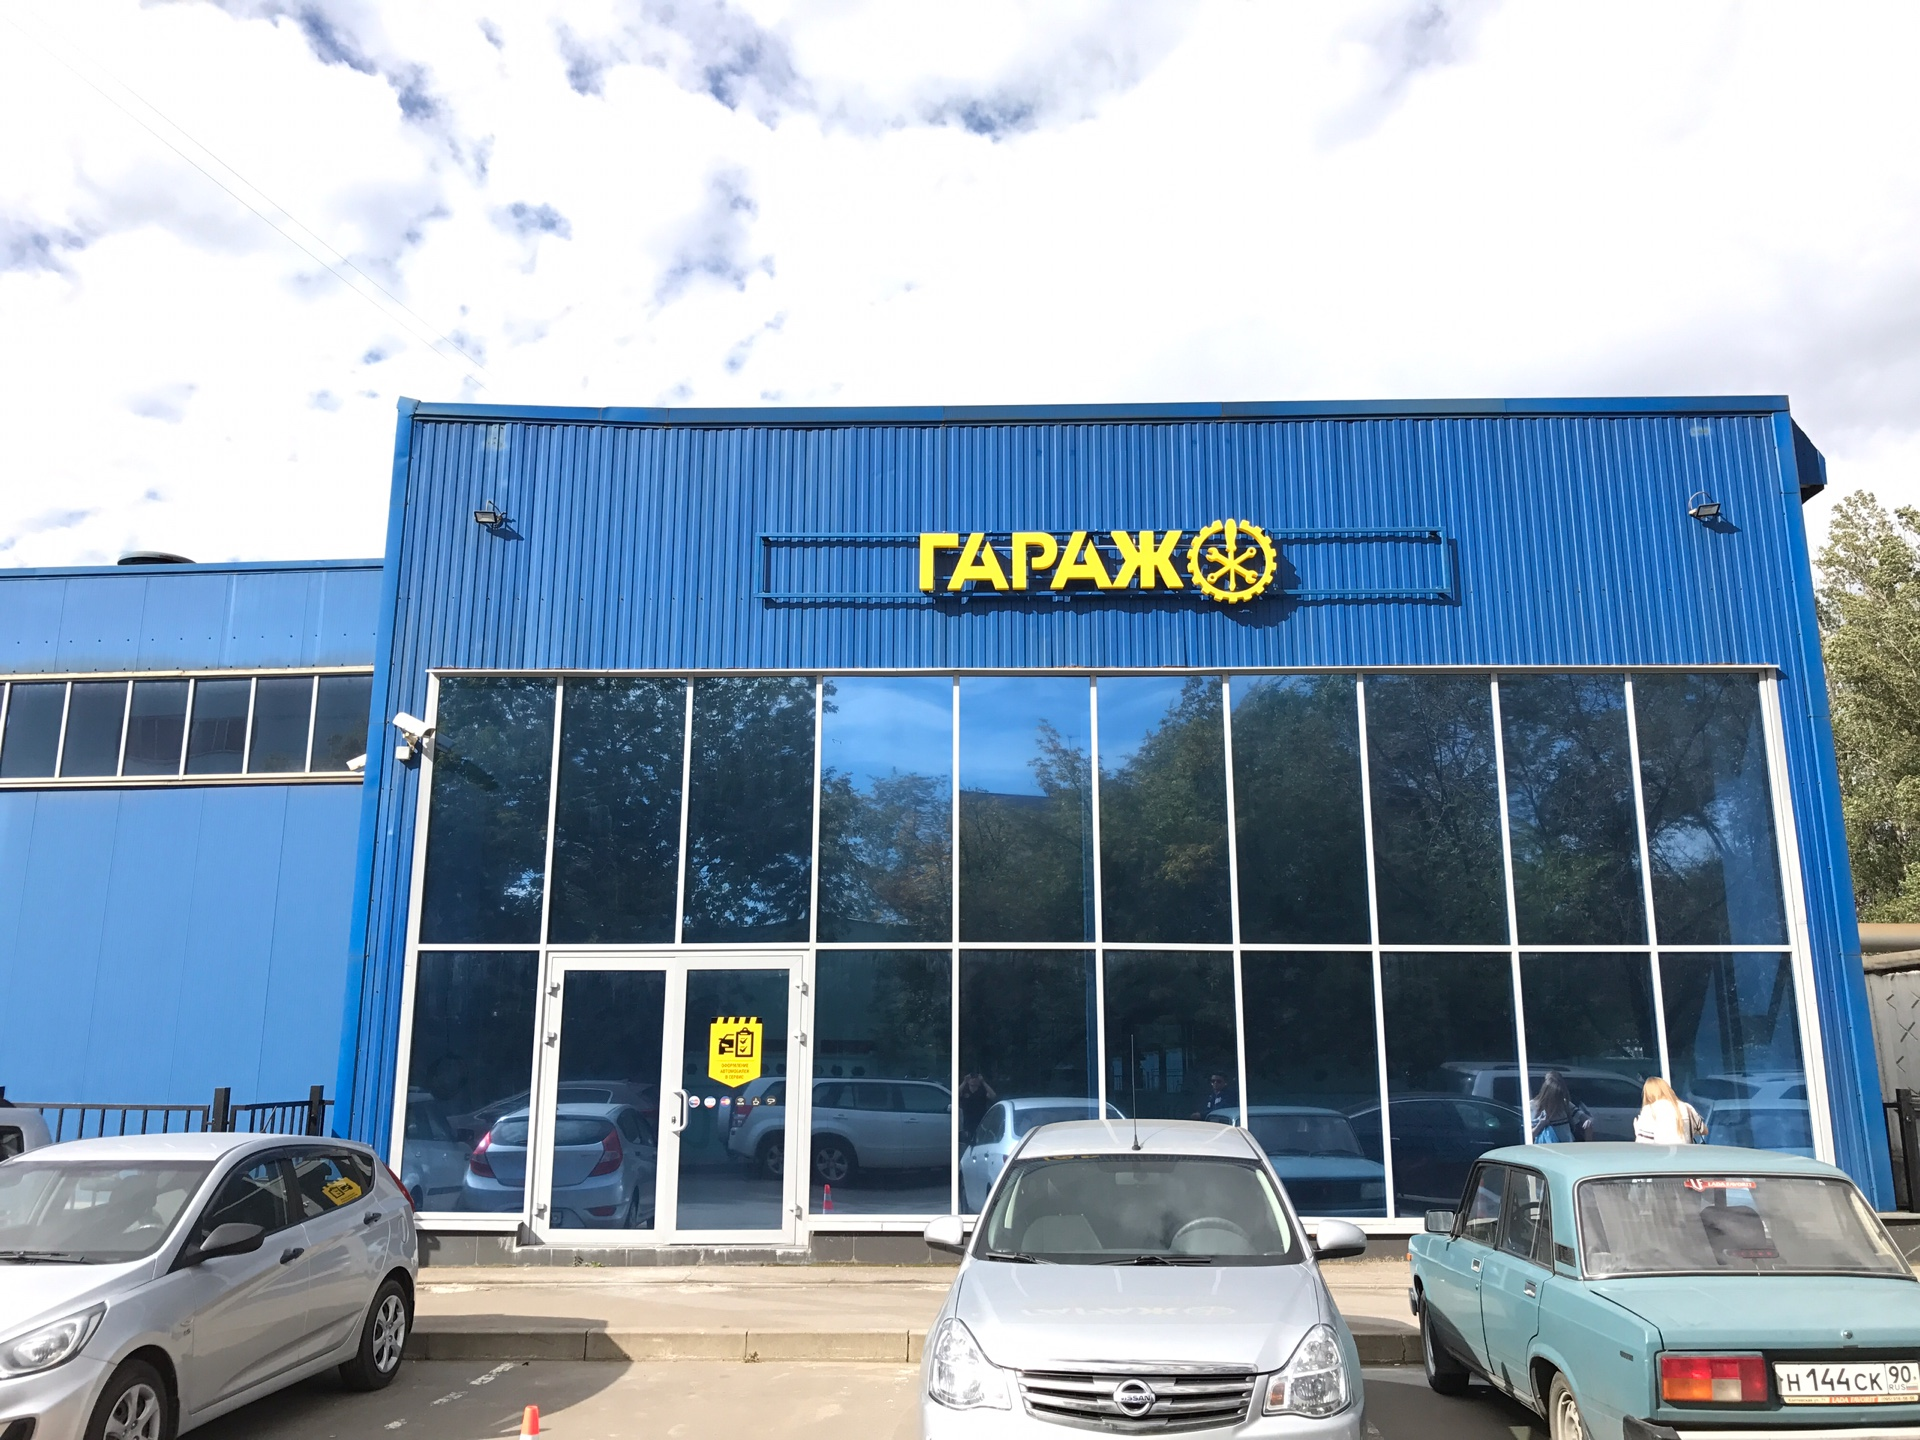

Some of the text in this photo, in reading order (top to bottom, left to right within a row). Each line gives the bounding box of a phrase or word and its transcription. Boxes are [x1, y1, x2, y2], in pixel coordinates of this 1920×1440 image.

[919, 531, 1184, 591] ГАРАЖ
[1888, 1365, 1912, 1384] 90
[1889, 1383, 1907, 1391] RUS
